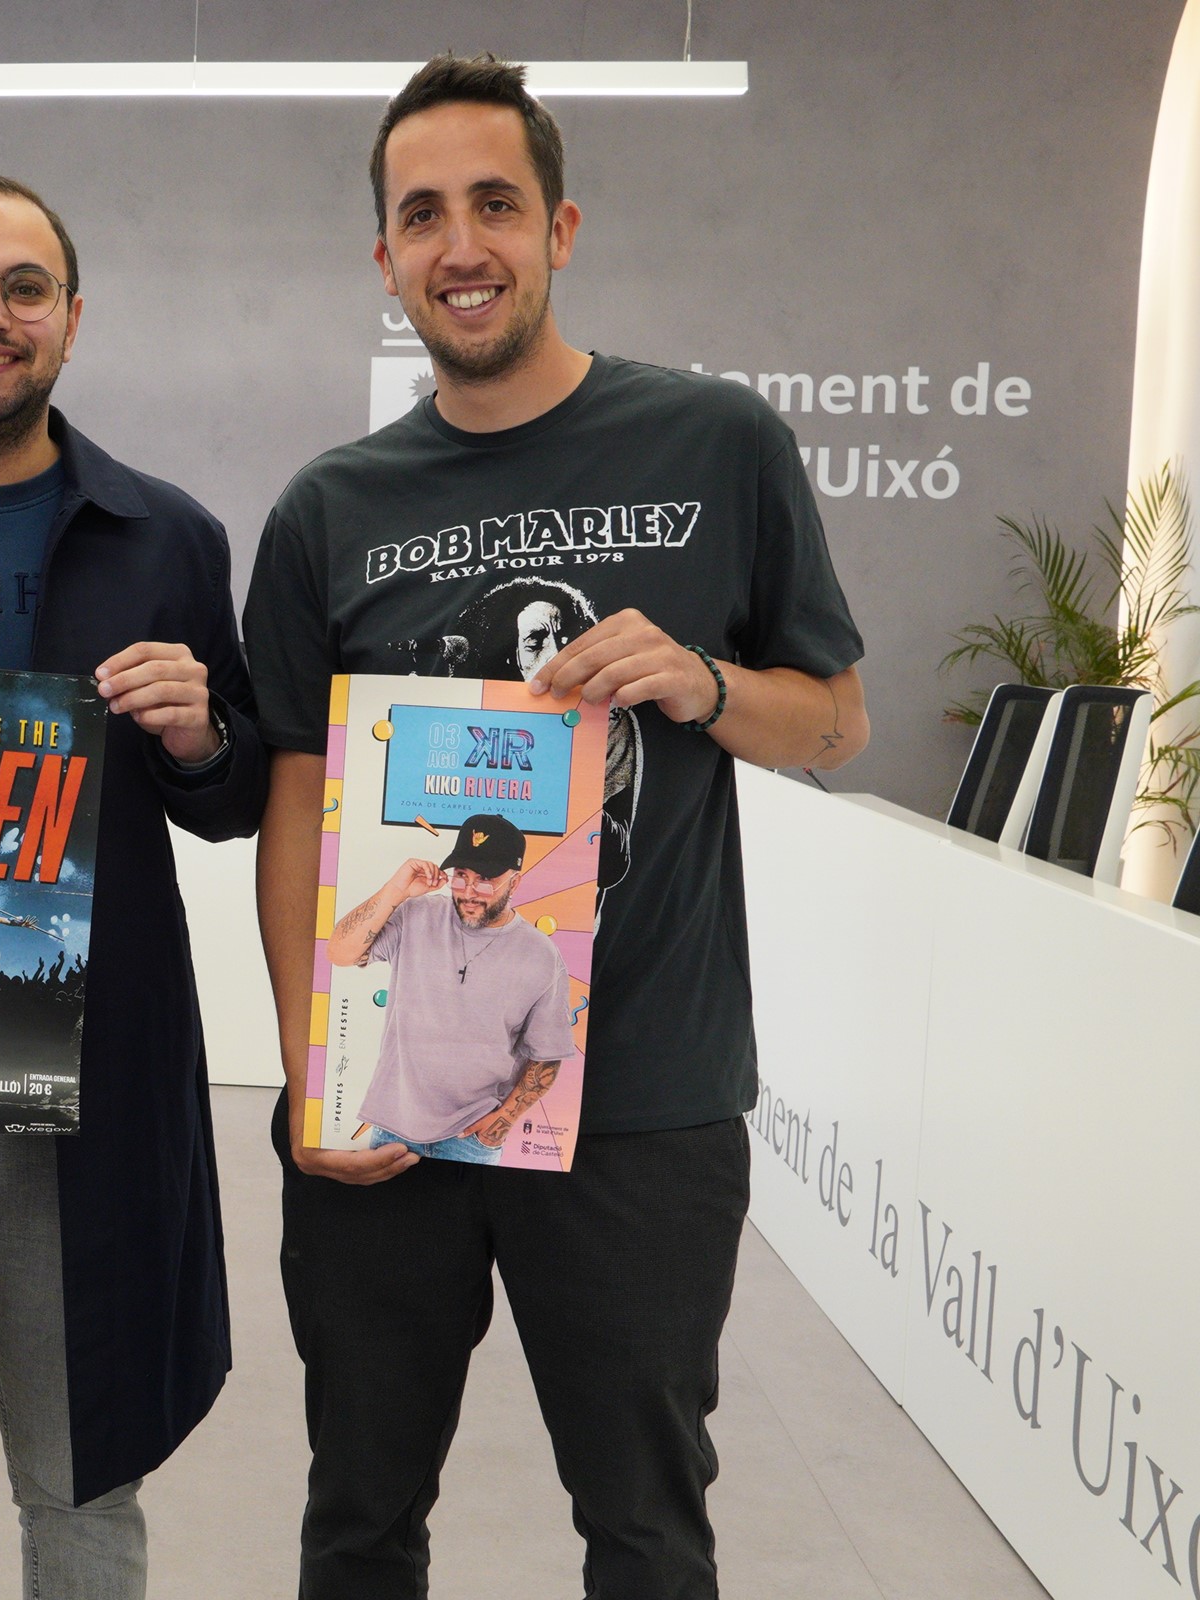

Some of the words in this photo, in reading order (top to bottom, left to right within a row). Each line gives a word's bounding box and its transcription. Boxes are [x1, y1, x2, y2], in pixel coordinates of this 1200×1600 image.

[950, 362, 1031, 417] de
[366, 525, 472, 584] BOB
[481, 502, 701, 559] MARLEY
[429, 564, 487, 583] KAYA
[493, 555, 564, 570] TOUR
[574, 552, 625, 564] 1978
[19, 719, 59, 748] THE
[428, 722, 461, 751] 03
[427, 751, 459, 769] AGO
[424, 774, 461, 796] KIKO
[464, 776, 532, 800] RIVERA
[400, 800, 423, 808] ZONA
[441, 803, 472, 811] CARPES
[334, 1082, 344, 1121] PENYES
[340, 998, 349, 1038] FESTES
[29, 1074, 53, 1082] ENTRADA
[53, 1075, 77, 1084] GENERAL
[29, 1082, 43, 1095] 20
[44, 1083, 52, 1096] €
[818, 1120, 854, 1227] de
[868, 1159, 899, 1279] la
[918, 1200, 998, 1384] Vall
[1012, 1307, 1200, 1600] d'Uix
